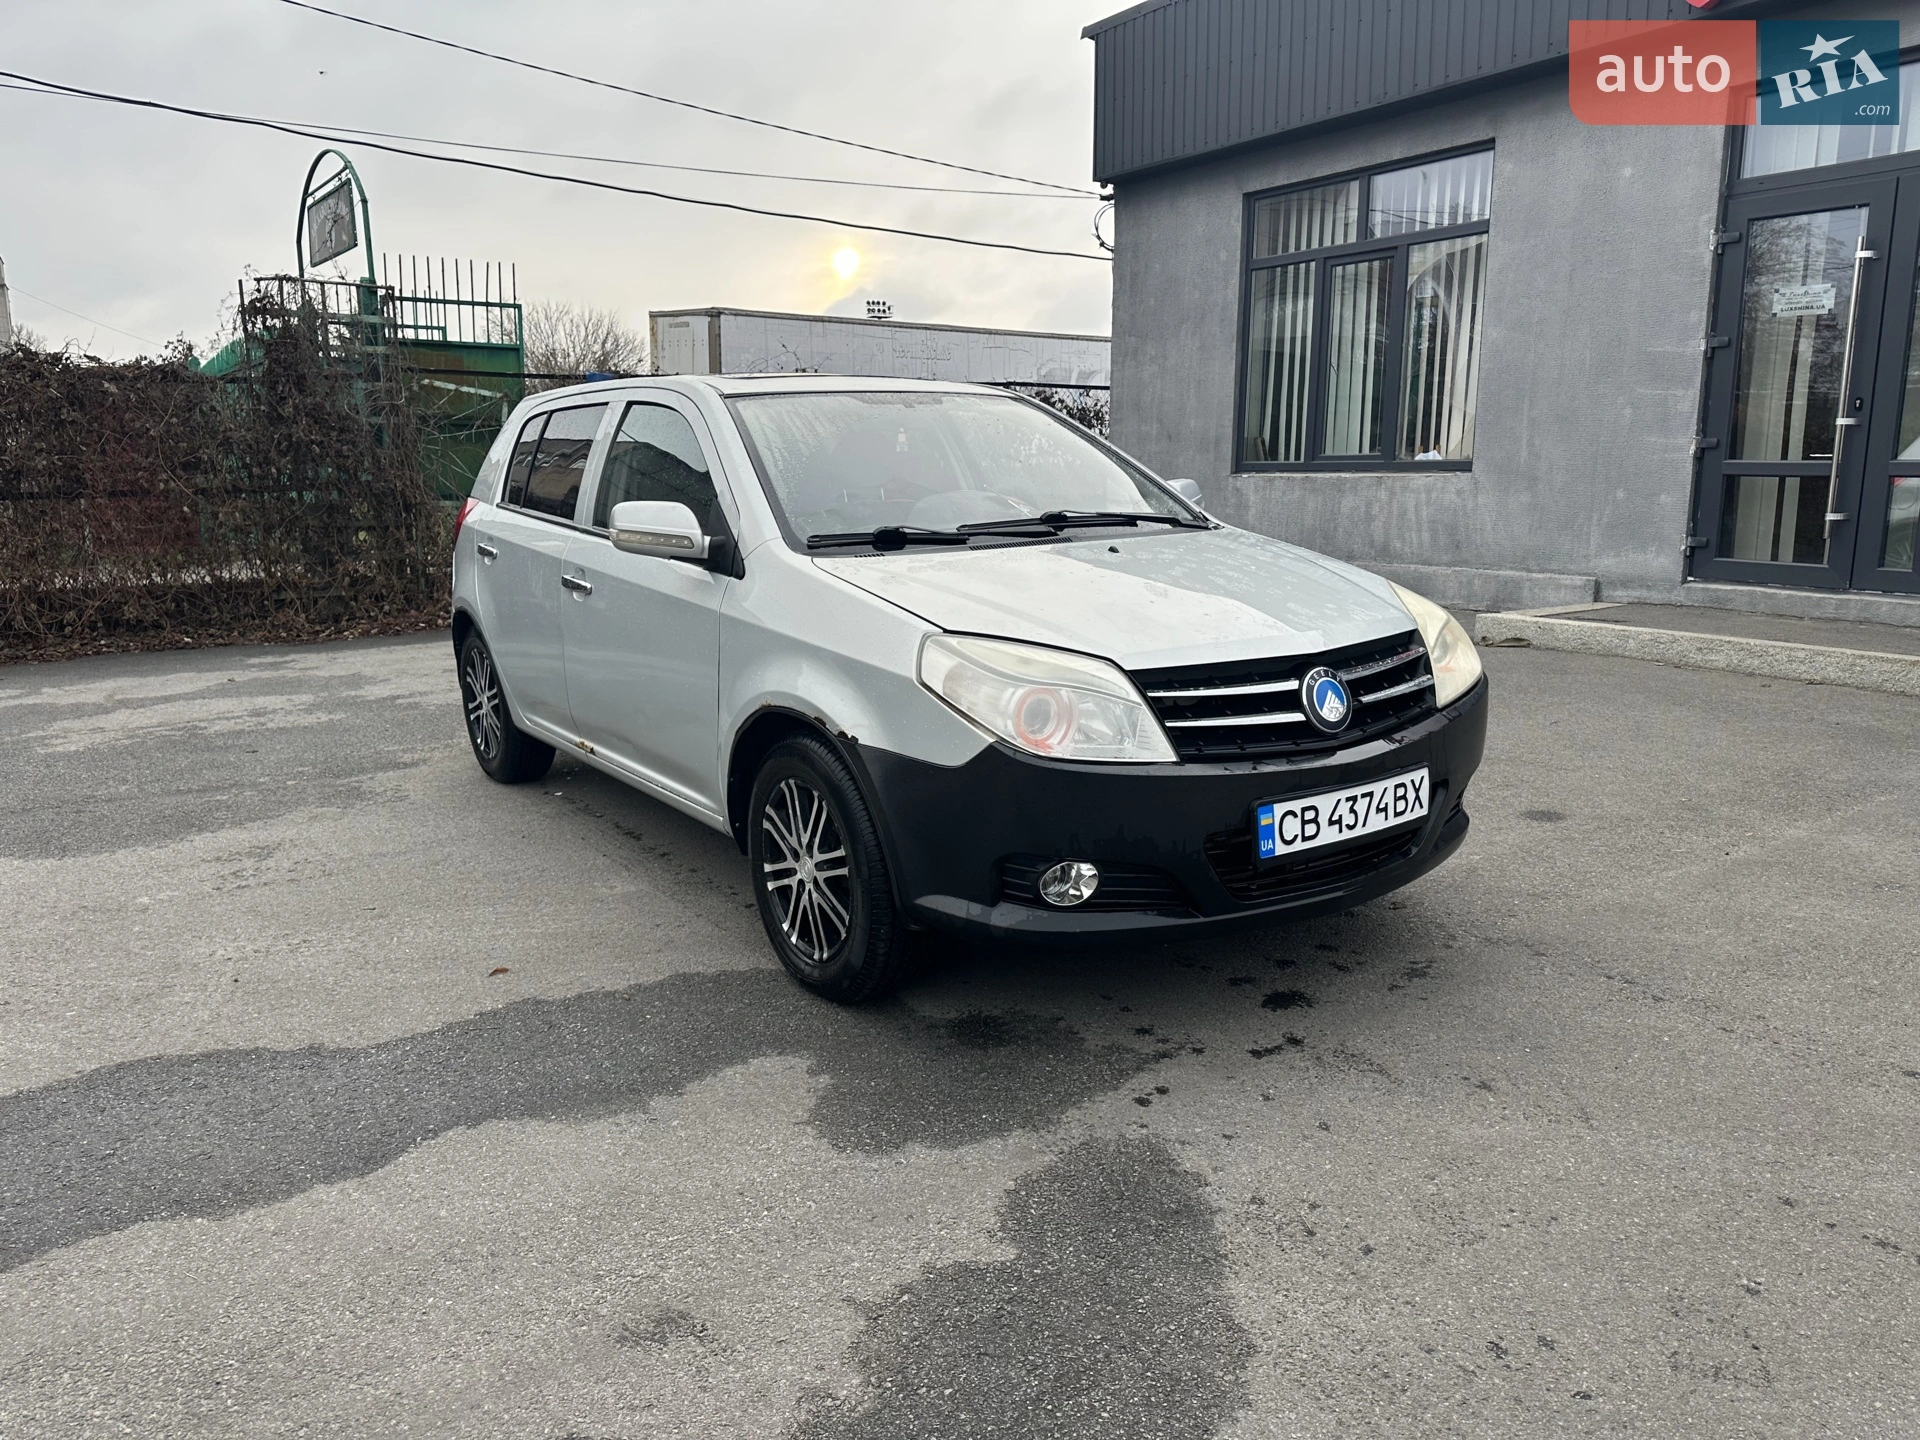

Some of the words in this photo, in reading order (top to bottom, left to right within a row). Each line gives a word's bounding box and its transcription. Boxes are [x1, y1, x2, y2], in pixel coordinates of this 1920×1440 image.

[1308, 669, 1341, 686] GEELY
[1278, 804, 1321, 846] CB
[1261, 839, 1274, 851] UA
